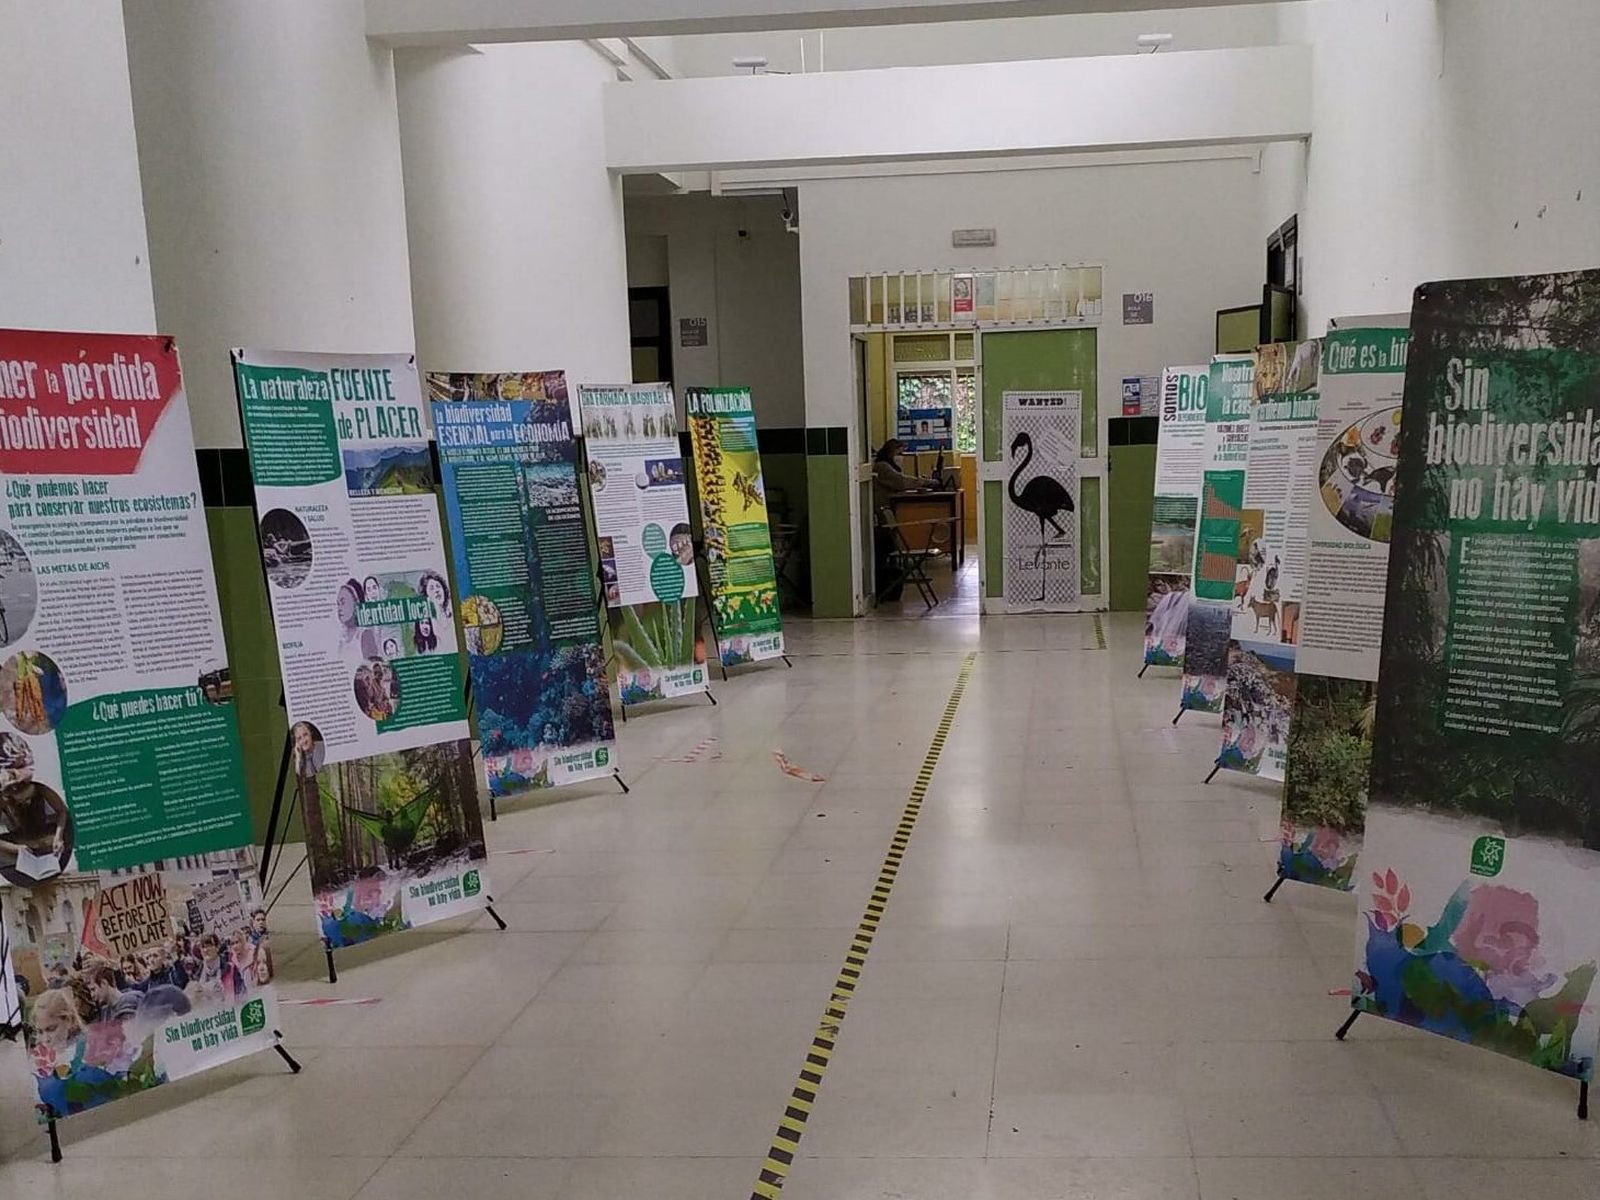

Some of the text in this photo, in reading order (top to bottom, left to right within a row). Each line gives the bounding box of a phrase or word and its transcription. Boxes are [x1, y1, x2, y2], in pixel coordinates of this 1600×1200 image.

[1360, 344, 1378, 369] es
[1378, 349, 1387, 366] la
[44, 368, 60, 395] la
[62, 349, 161, 405] pérdida
[241, 368, 396, 401] La naturaleza FUENTE
[1444, 357, 1490, 411] Sin
[687, 392, 700, 413] LA
[1163, 374, 1179, 422] SOMOS
[337, 406, 422, 440] de PLACER
[444, 403, 512, 424] biodiversidad
[437, 424, 491, 447] ESENCIAL
[513, 421, 571, 444] ECONOMÍA
[6, 479, 109, 499] ¿Qué podemos hacer
[1450, 477, 1482, 520] no
[1493, 468, 1546, 531] hay
[8, 491, 197, 519] para conservar nuestros ecosistemas?
[37, 565, 51, 575] LAS
[52, 563, 77, 574] METAS
[78, 562, 88, 572] DE
[406, 598, 432, 622] local
[92, 698, 118, 722] ¿Qué
[121, 697, 155, 720] puedes
[156, 694, 183, 713] hacer
[99, 882, 131, 917] ACT
[101, 904, 147, 937] BEFORE
[109, 919, 168, 955] TOO LATE
[164, 1007, 237, 1043] Sin biodiversidad
[191, 1024, 239, 1051] no hay vida
